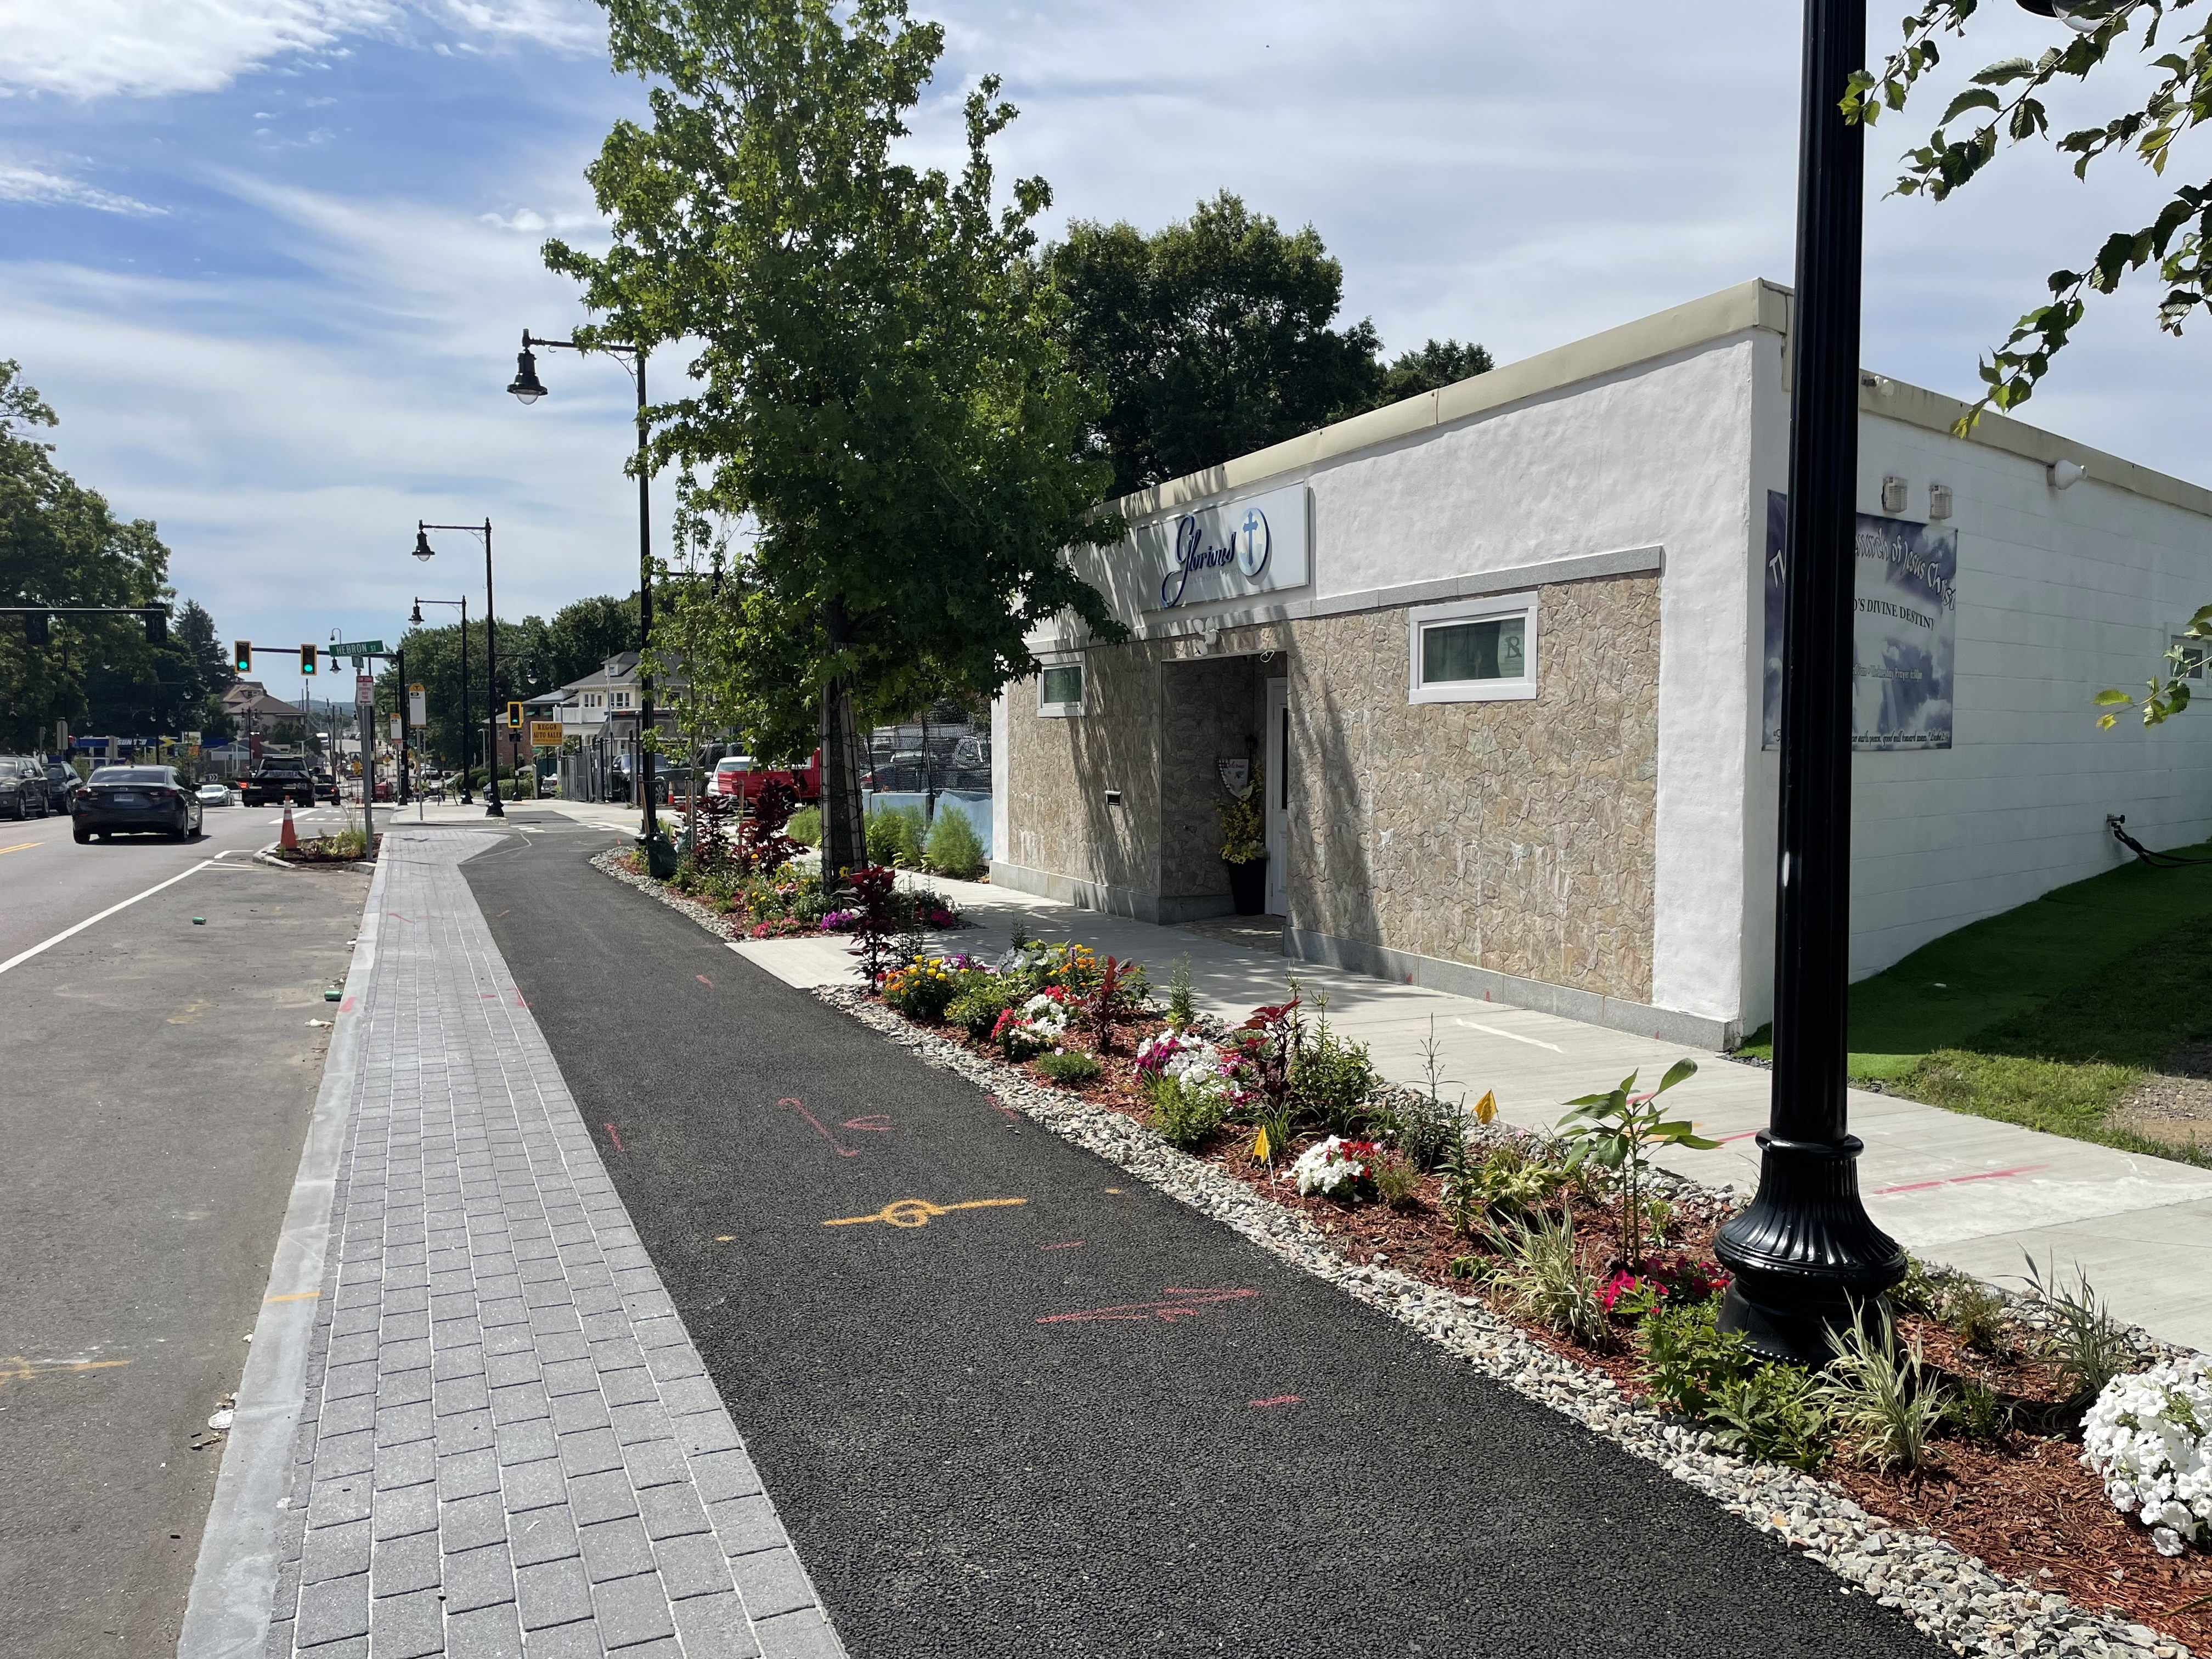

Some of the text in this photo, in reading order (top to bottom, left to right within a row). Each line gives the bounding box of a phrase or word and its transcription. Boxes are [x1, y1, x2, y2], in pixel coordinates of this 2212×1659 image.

[1160, 514, 1237, 608] Glorious
[1855, 526, 1889, 562] hurch
[1891, 533, 1902, 566] of
[1900, 540, 1927, 580] Jesus
[1926, 560, 1957, 611] Christ
[1866, 599, 1898, 617] DIVINE
[1899, 606, 1936, 631] DESTINY
[336, 644, 367, 655] HEBRON
[1895, 667, 1909, 682] Prayer
